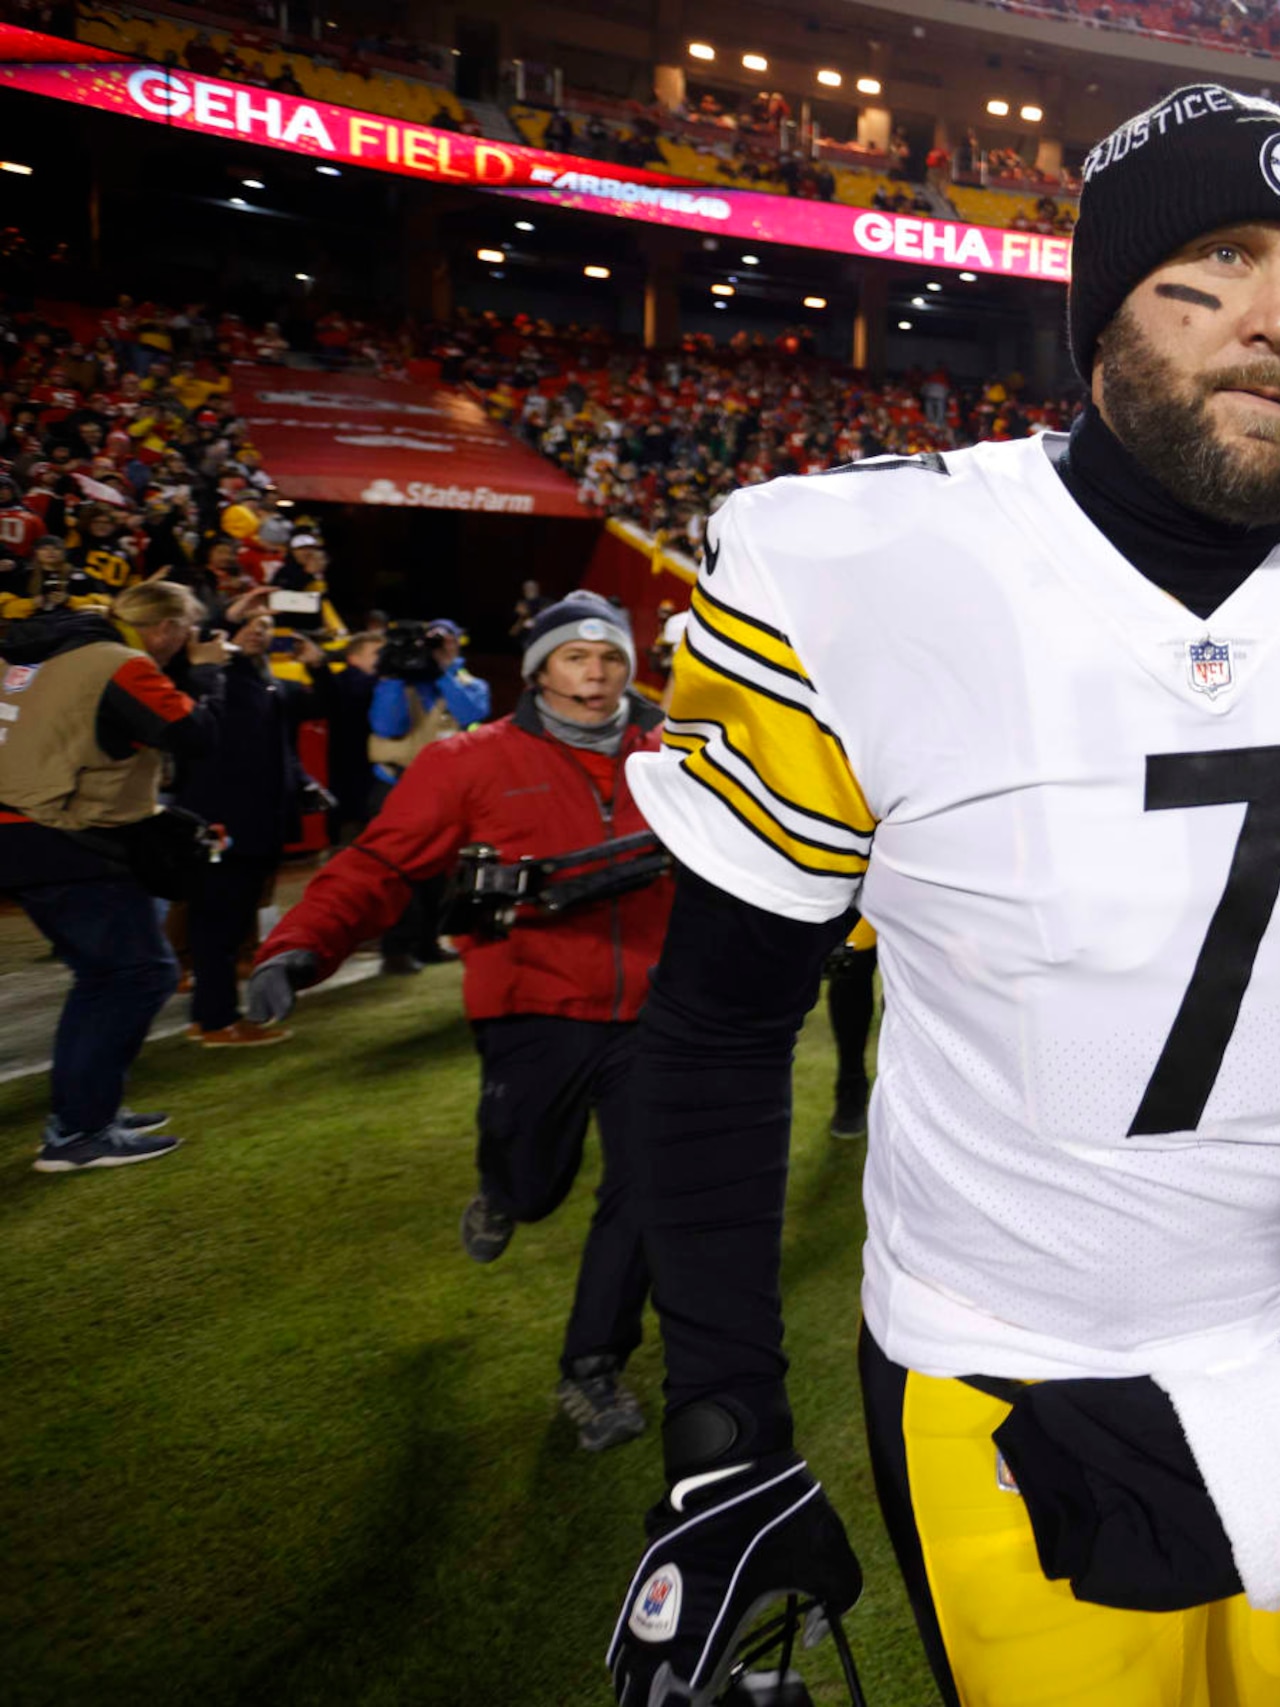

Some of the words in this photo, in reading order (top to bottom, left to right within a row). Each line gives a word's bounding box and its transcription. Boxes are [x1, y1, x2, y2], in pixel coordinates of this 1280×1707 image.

[126, 69, 335, 151] GEHA
[350, 116, 514, 181] FIELD
[853, 212, 994, 268] GEHA
